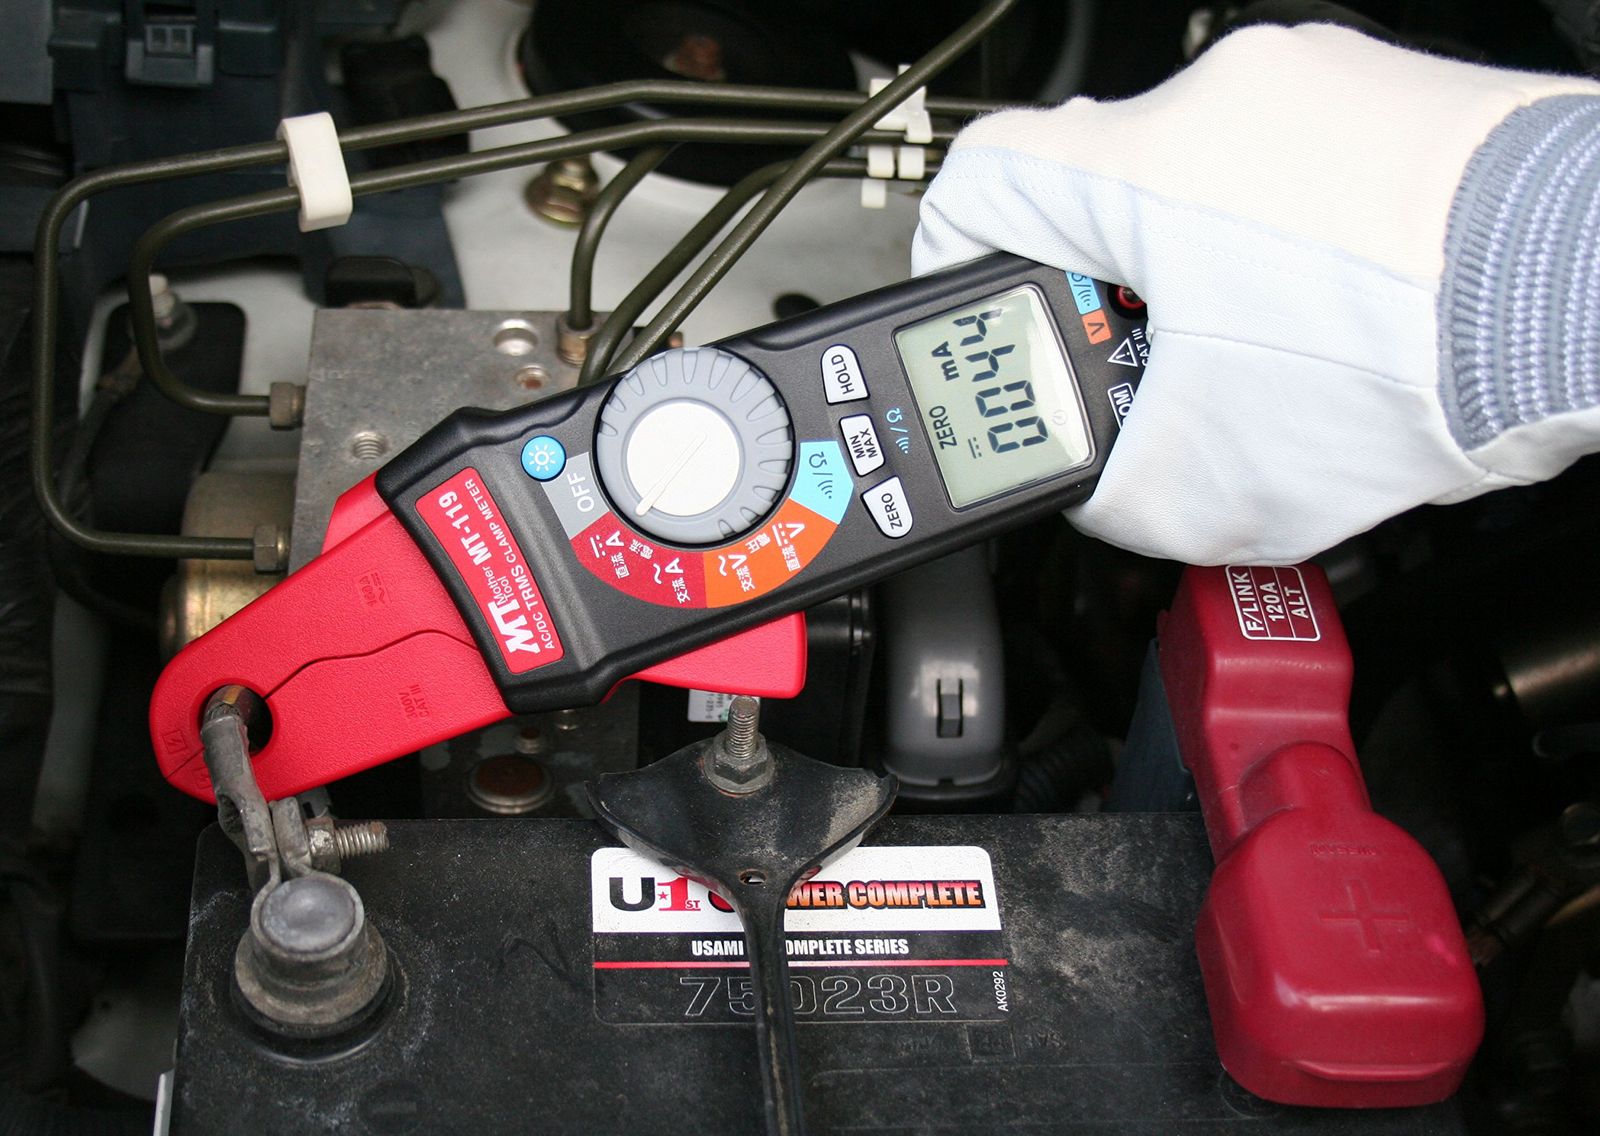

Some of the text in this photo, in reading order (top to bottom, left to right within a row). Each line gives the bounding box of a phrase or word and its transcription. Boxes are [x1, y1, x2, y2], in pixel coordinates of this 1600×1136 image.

[831, 354, 855, 394] HOLD
[931, 340, 960, 382] mA
[952, 308, 1049, 454] 0044
[1113, 389, 1134, 416] OM
[859, 428, 878, 459] MAX
[929, 405, 958, 450] ZERO
[849, 435, 867, 459] MIN
[567, 472, 594, 513] OFF
[881, 492, 903, 530] ZERO
[438, 490, 492, 565] MT-119
[465, 478, 555, 650] AC/DC TRMS CLAMP METER
[610, 551, 630, 579] 直流
[781, 544, 801, 572] 直流
[482, 565, 508, 605] Mother
[499, 575, 515, 601] Tool
[672, 577, 691, 604] 交流
[736, 565, 756, 592] 交流
[1232, 572, 1264, 631] F/LINK
[1260, 582, 1285, 621] 120A
[1284, 586, 1309, 619] ALT
[786, 881, 983, 908] WER COMPLETE
[691, 938, 910, 956] USAMI OMPLETE SERIES
[992, 970, 1009, 1012] AK0292
